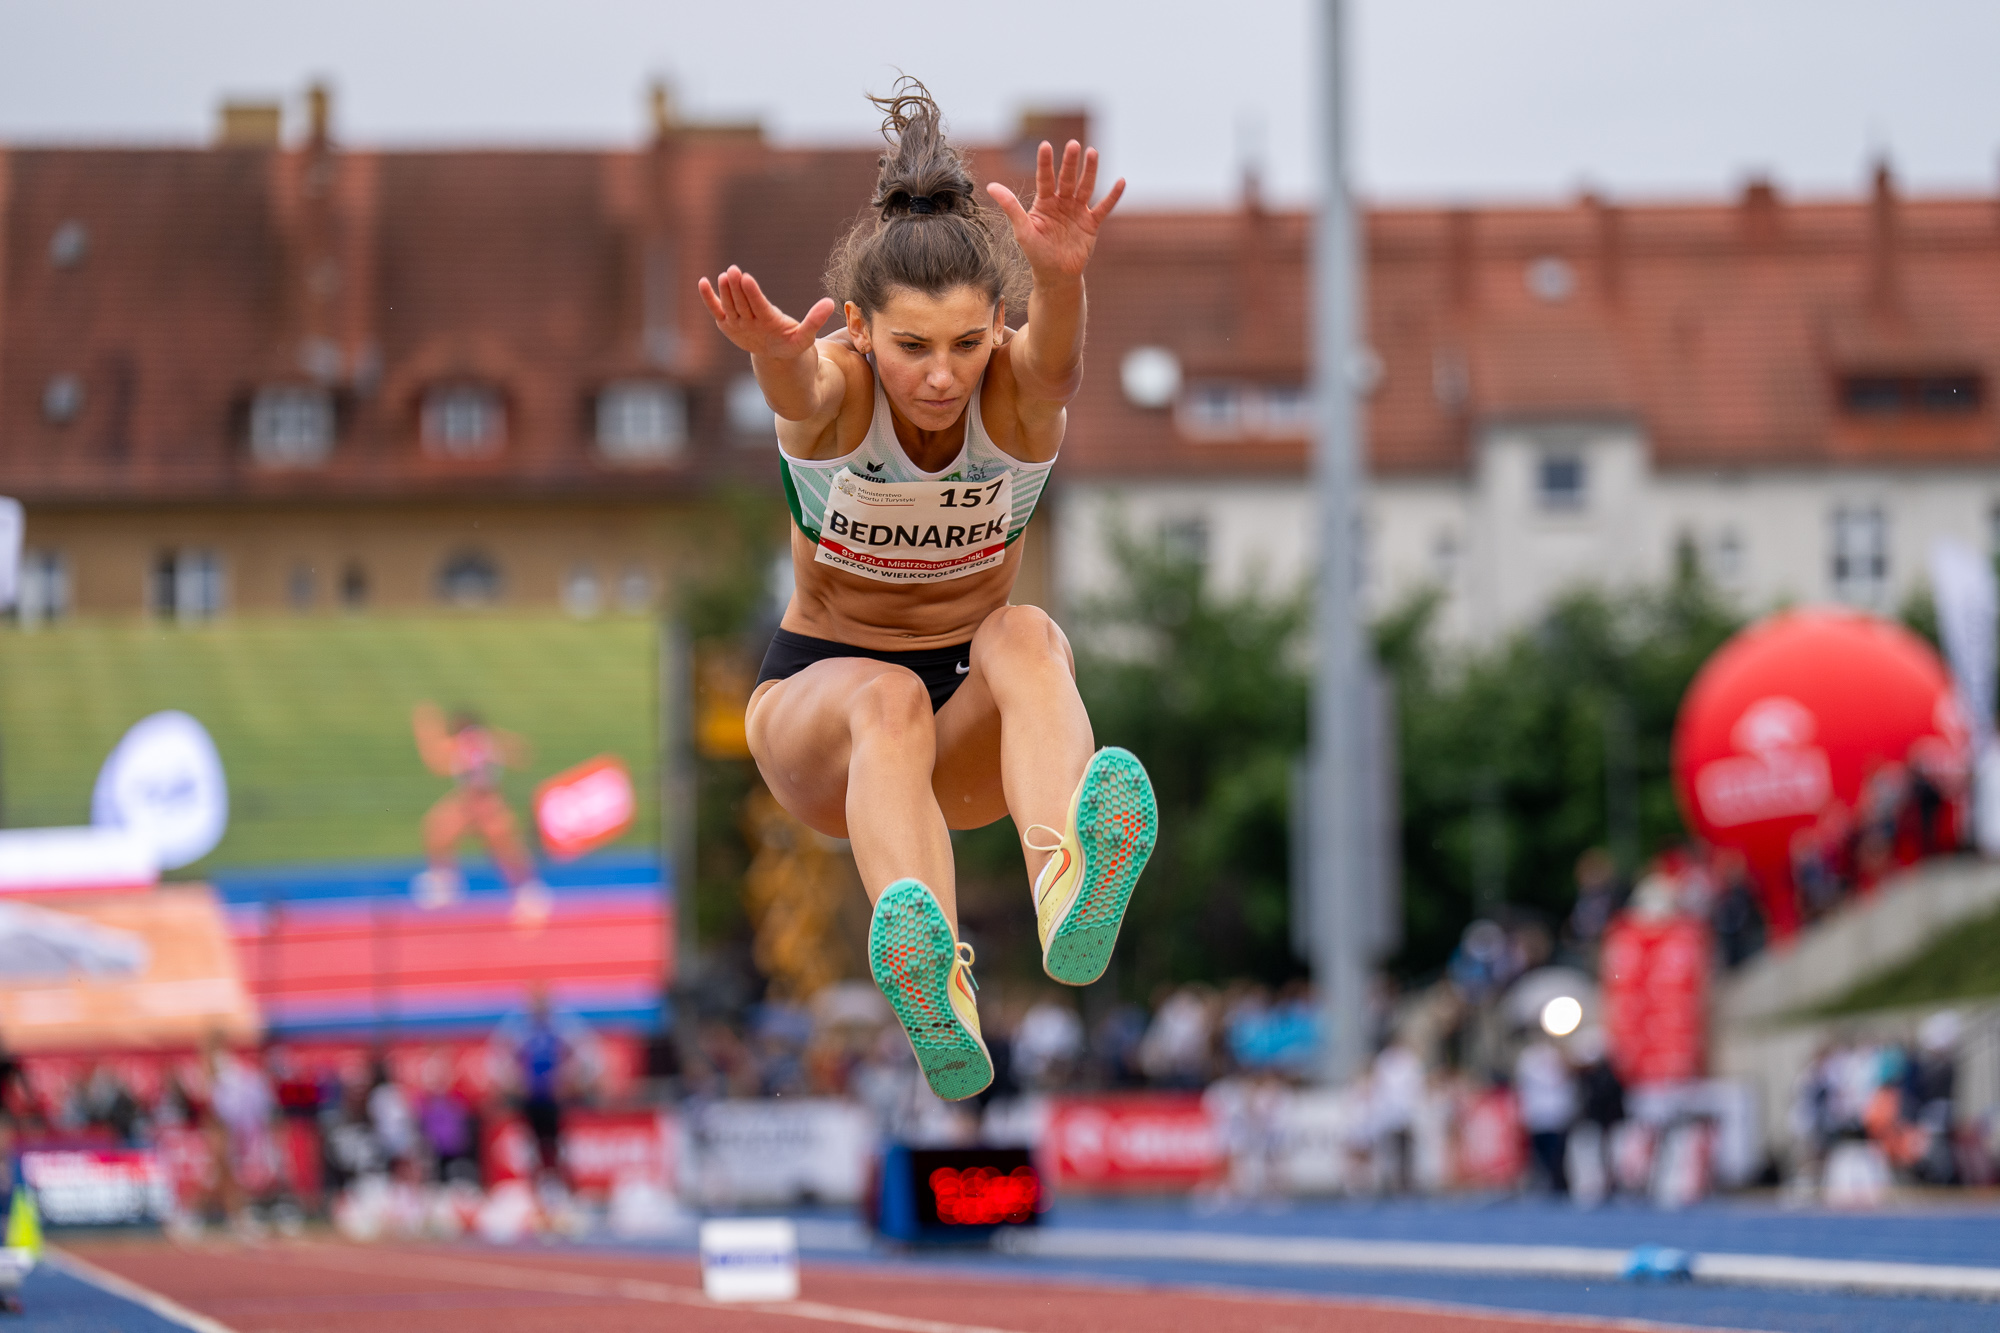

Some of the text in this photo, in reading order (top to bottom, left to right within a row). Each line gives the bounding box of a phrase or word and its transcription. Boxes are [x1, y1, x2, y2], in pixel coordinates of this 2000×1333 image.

[857, 493, 880, 503] Sportu
[858, 487, 902, 498] Ministerstwo
[940, 478, 1003, 508] 157
[830, 509, 1006, 549] BEDNAREK
[841, 548, 857, 560] 99.
[859, 555, 884, 567] PZLA
[887, 560, 953, 570] Mistrzostwa
[880, 565, 967, 579] WIELKOPOLSKI
[968, 557, 996, 568] 2023
